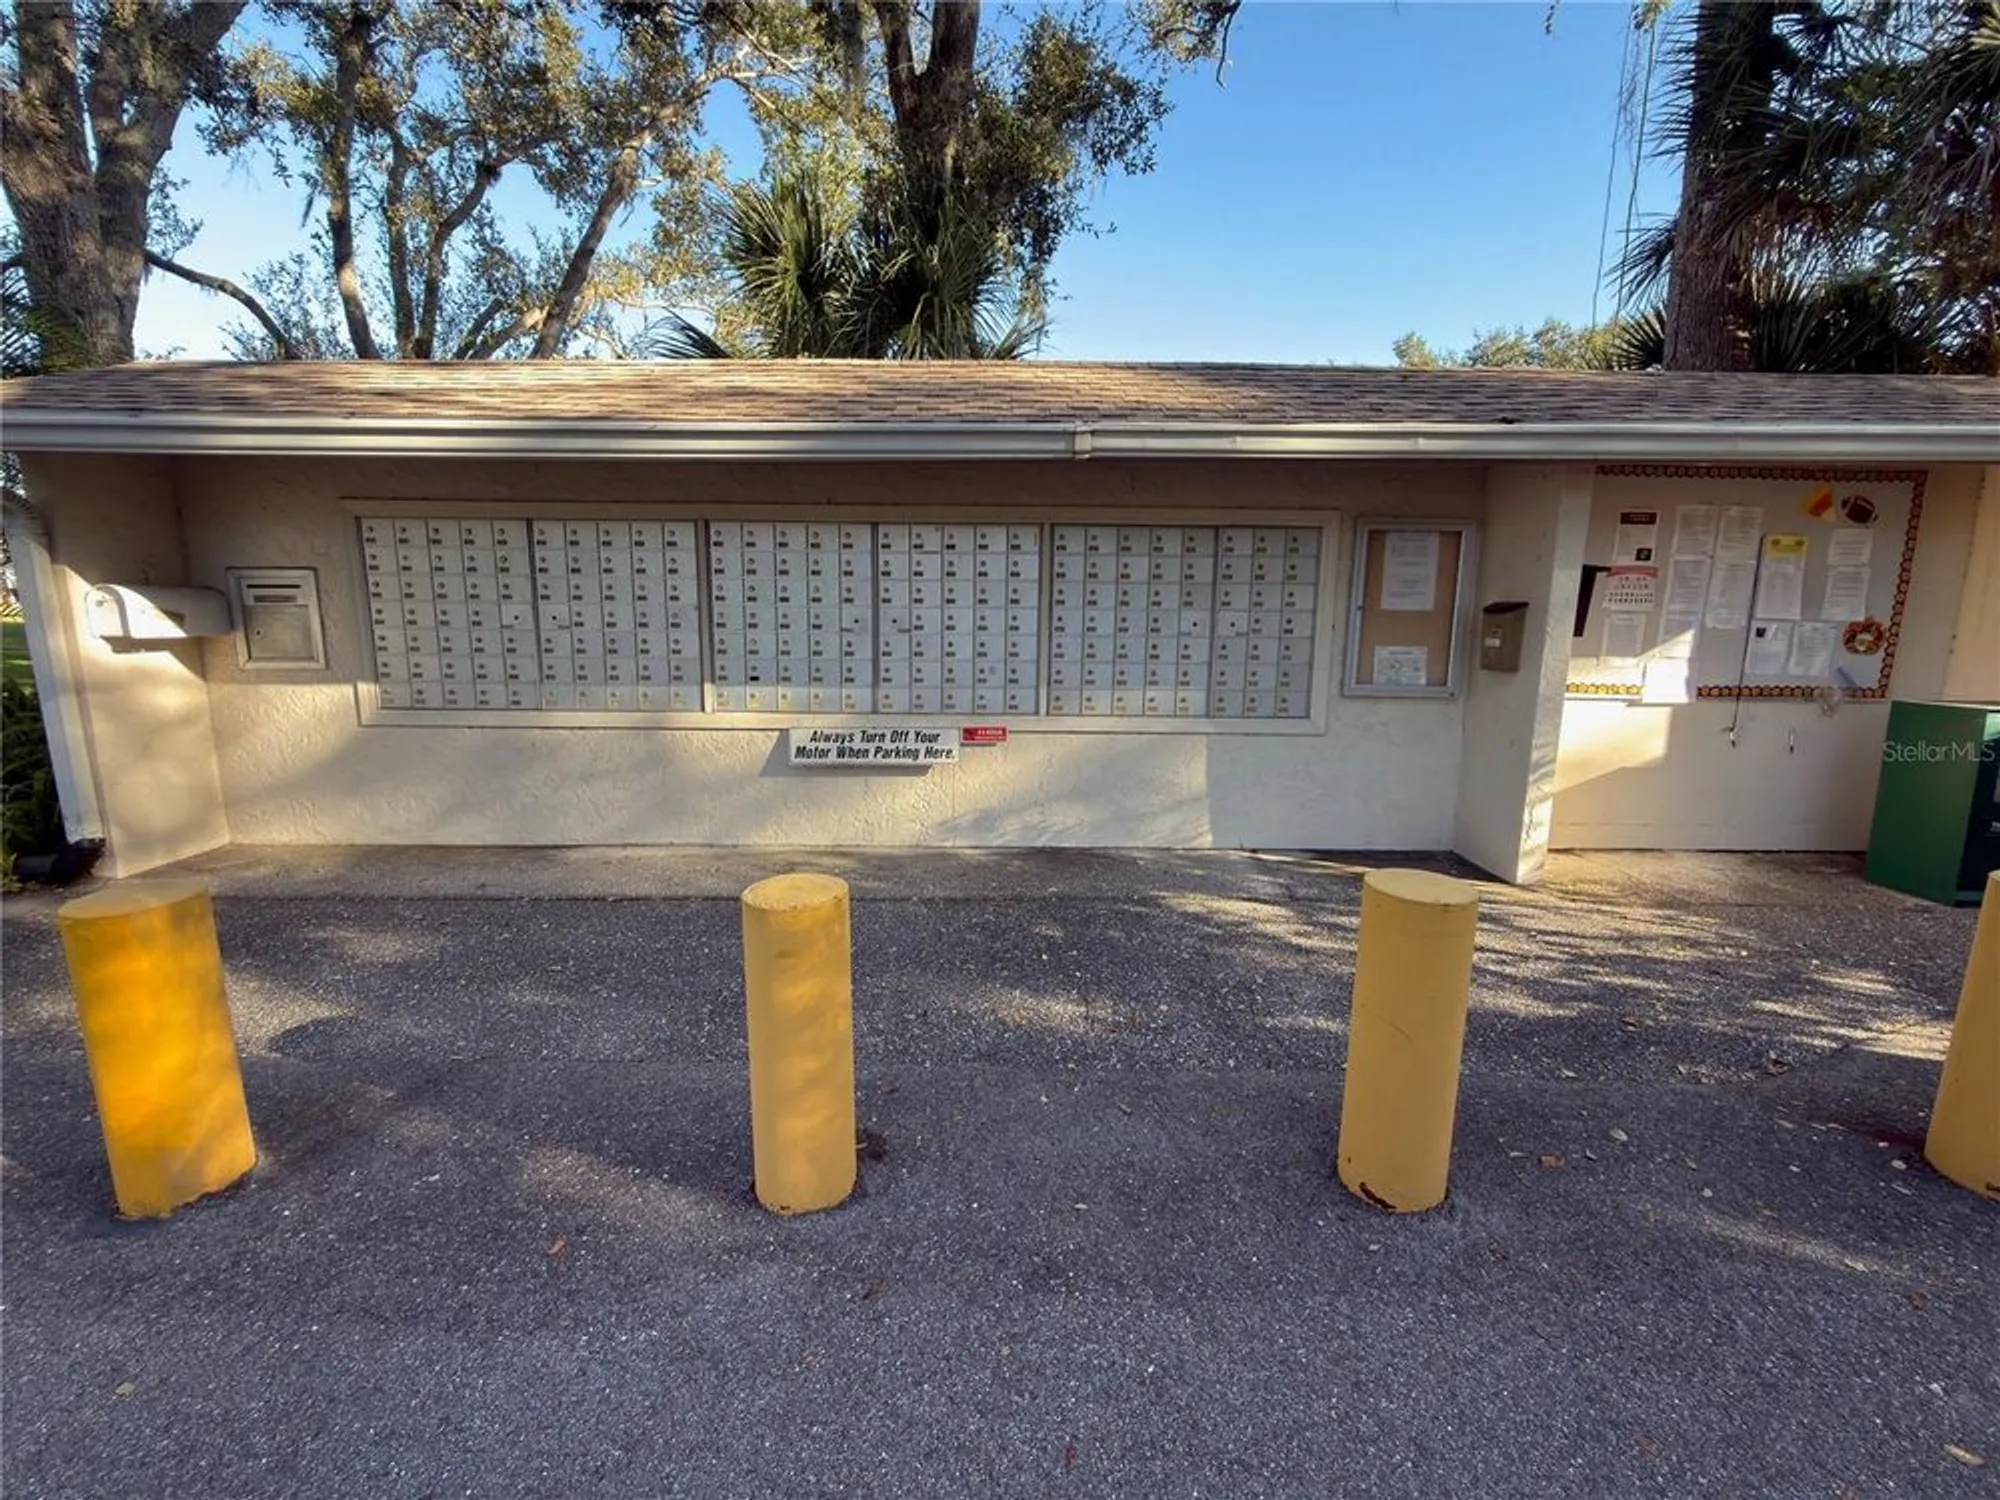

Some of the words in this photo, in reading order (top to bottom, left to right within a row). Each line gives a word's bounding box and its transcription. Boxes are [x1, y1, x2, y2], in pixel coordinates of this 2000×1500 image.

[810, 730, 855, 745] Always
[860, 730, 886, 743] Turn
[890, 730, 910, 743] Off
[914, 730, 940, 743] Your
[795, 746, 831, 759] Motor
[836, 746, 870, 759] When
[874, 746, 920, 761] Parking
[924, 746, 955, 759] Here.
